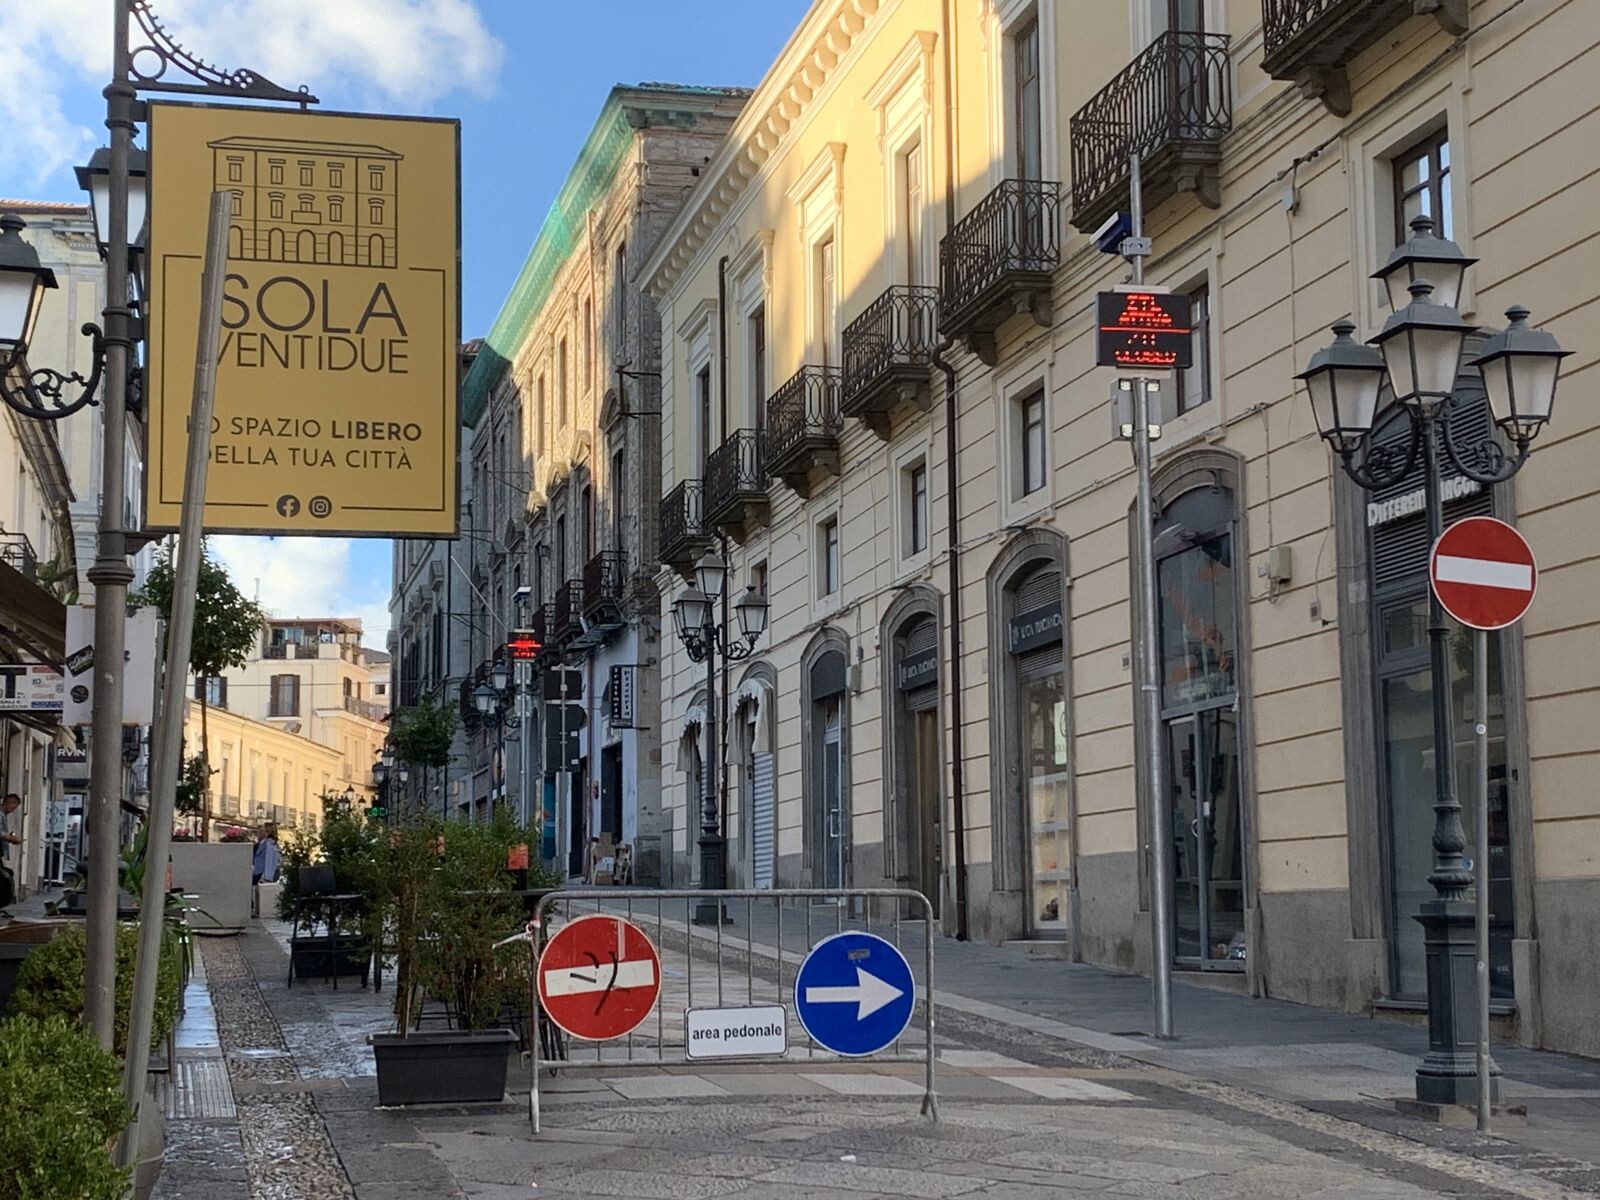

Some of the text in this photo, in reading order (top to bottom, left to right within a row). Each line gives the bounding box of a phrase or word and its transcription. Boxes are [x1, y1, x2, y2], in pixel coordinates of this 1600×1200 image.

[201, 273, 408, 337] SOLA
[230, 416, 321, 438] SPAZIO
[331, 420, 422, 442] LIBERO
[207, 445, 413, 470] ELLA TUA CITTÀ
[692, 1023, 782, 1041] area pedonale
